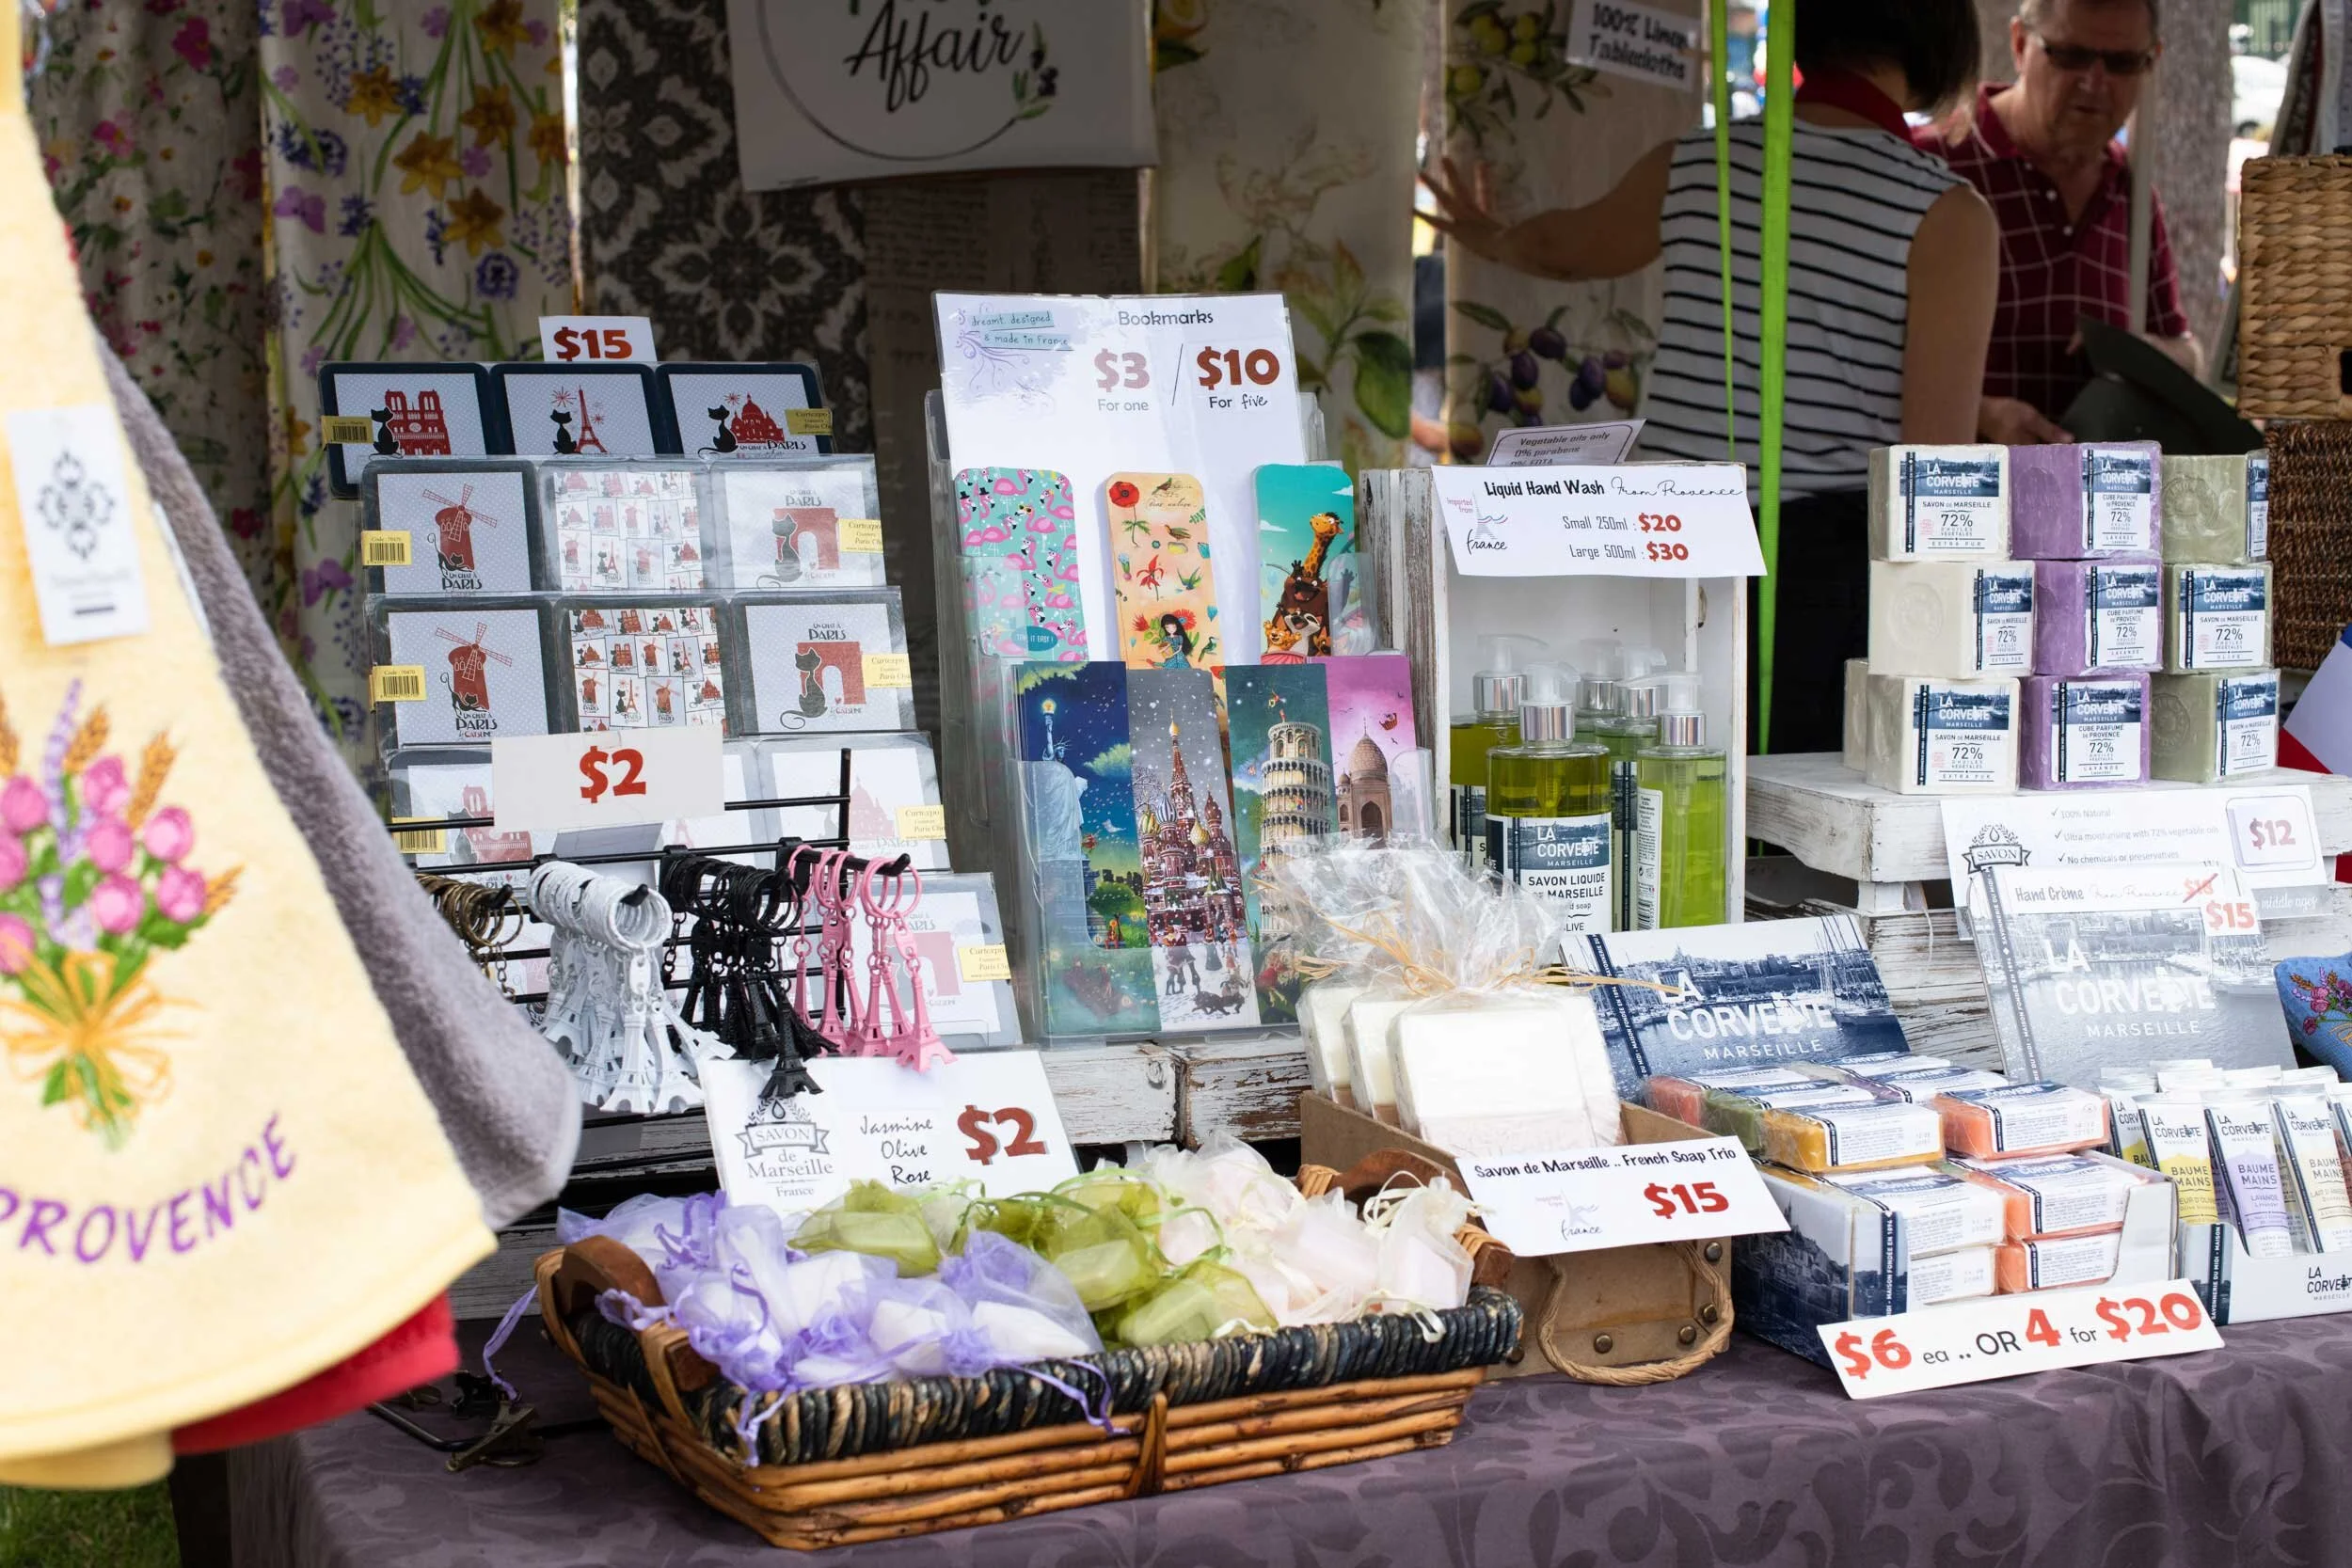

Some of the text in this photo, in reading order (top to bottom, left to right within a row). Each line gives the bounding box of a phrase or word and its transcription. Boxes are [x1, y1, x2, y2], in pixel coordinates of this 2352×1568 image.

[844, 0, 1025, 113] Affair
[1010, 310, 1051, 325] designed
[1118, 309, 1215, 326] Bookmarks
[553, 326, 633, 361] $15
[994, 333, 1018, 343] made
[1024, 335, 1033, 344] in
[1094, 346, 1280, 392] $3 $10
[1098, 393, 1268, 411] For one For five
[1520, 436, 1568, 446] Vegetable
[1926, 463, 1941, 475] LA
[2101, 460, 2111, 470] LA
[1926, 475, 1980, 487] CORVETE
[2101, 472, 2138, 484] CORVETE
[1484, 476, 1743, 499] Liquid Hand Wash From Provence
[1562, 512, 1682, 533] Small 250ml $20
[1941, 514, 1973, 527] 72%
[2110, 511, 2131, 523] 72%
[1568, 541, 1689, 562] Large 500ml $30
[441, 578, 483, 591] PARIS
[1989, 579, 1999, 592] LA
[2106, 575, 2117, 587] LA
[2203, 579, 2217, 591] LA
[1989, 592, 2021, 604] CORVETE
[2106, 586, 2145, 600] CORVETE
[2203, 591, 2250, 603] CORVETE
[2106, 609, 2121, 617] CUBE
[808, 628, 847, 641] PARIS
[1997, 630, 2017, 642] 72%
[2116, 626, 2137, 638] 72%
[2216, 627, 2244, 641] 72%
[2076, 690, 2090, 703] LA
[2233, 687, 2243, 698] LA
[1938, 695, 1953, 707] LA
[2233, 696, 2265, 709] CORVETE
[1938, 708, 1991, 721] CORVETE
[2076, 703, 2125, 715] CORVETE
[455, 718, 498, 731] PARIS
[2089, 741, 2114, 753] 72%
[2240, 734, 2261, 747] 72%
[1952, 747, 1983, 760] 72%
[579, 745, 647, 804] $2
[1536, 827, 1556, 841] LA
[2249, 816, 2296, 850] $12
[1536, 841, 1600, 858] CORVETE
[1978, 848, 2018, 862] SAVON
[1546, 858, 1594, 867] MARSEILLE
[2067, 855, 2079, 864] No
[2080, 853, 2118, 863] chemicals
[2128, 850, 2180, 863] preservatives
[1528, 872, 1606, 886] SAVON LIQUIDE
[1547, 886, 1604, 899] MARSEILLE
[2015, 887, 2045, 902] Hand
[2048, 886, 2085, 900] Crème
[2205, 899, 2256, 930] $15
[1564, 922, 1585, 932] LIVE
[2045, 939, 2091, 973] LA
[1652, 969, 1705, 1004] LA
[2054, 973, 2217, 1015] CORVETE
[1666, 999, 1837, 1041] CORVETE
[2087, 1020, 2201, 1038] MARSEILLE
[1704, 1038, 1824, 1061] MARSEILLE
[2151, 1114, 2164, 1126] LA
[2217, 1115, 2232, 1125] LA
[2285, 1108, 2297, 1119] LA
[2221, 1123, 2271, 1136] CORVETE
[2290, 1118, 2332, 1131] CORVETE
[755, 1126, 811, 1143] SAVON
[860, 1103, 1048, 1166] Jasmine $2
[2154, 1126, 2202, 1139] CORVETE
[778, 1148, 797, 1163] de
[881, 1138, 928, 1160] Olive
[746, 1158, 834, 1179] Marseille
[1473, 1147, 1737, 1178] Savon de Marseille French Soap Trio
[2237, 1164, 2275, 1174] BAUME
[2309, 1157, 2341, 1168] BAUME
[891, 1164, 931, 1184] Rose
[2170, 1165, 2209, 1176] BAUME
[2312, 1168, 2344, 1180] MAINS
[2175, 1176, 2212, 1187] MAINS
[2240, 1174, 2278, 1185] MAINS
[775, 1185, 816, 1197] France
[1644, 1181, 1729, 1219] $15
[2308, 1266, 2322, 1279] LA
[2307, 1276, 2352, 1293] CORVET
[1834, 1291, 2203, 1380] $6 ea OR 4 for $20
